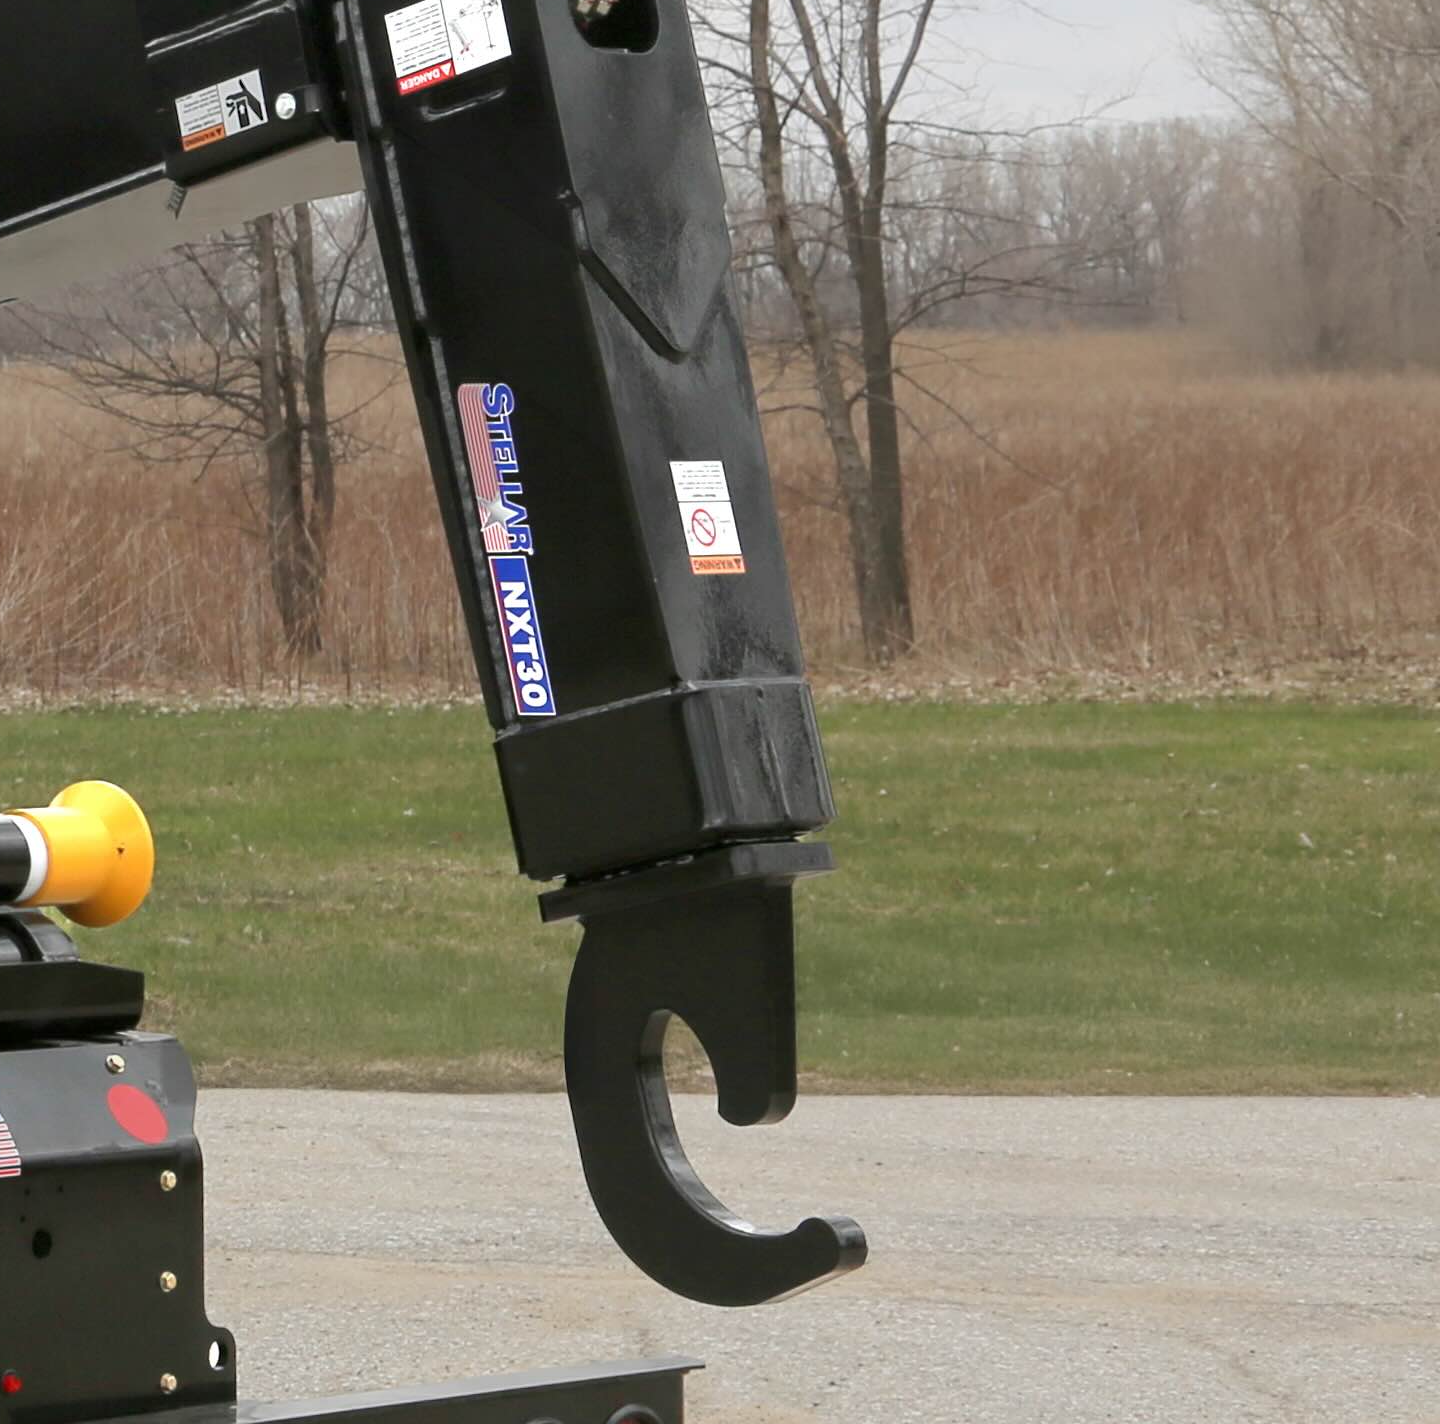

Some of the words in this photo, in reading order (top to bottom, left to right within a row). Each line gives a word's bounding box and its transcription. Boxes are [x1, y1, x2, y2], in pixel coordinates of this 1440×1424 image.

[399, 68, 440, 90] DANGER
[481, 383, 533, 555] STELLAR
[694, 558, 733, 570] WARNING
[500, 581, 548, 707] NXT30
